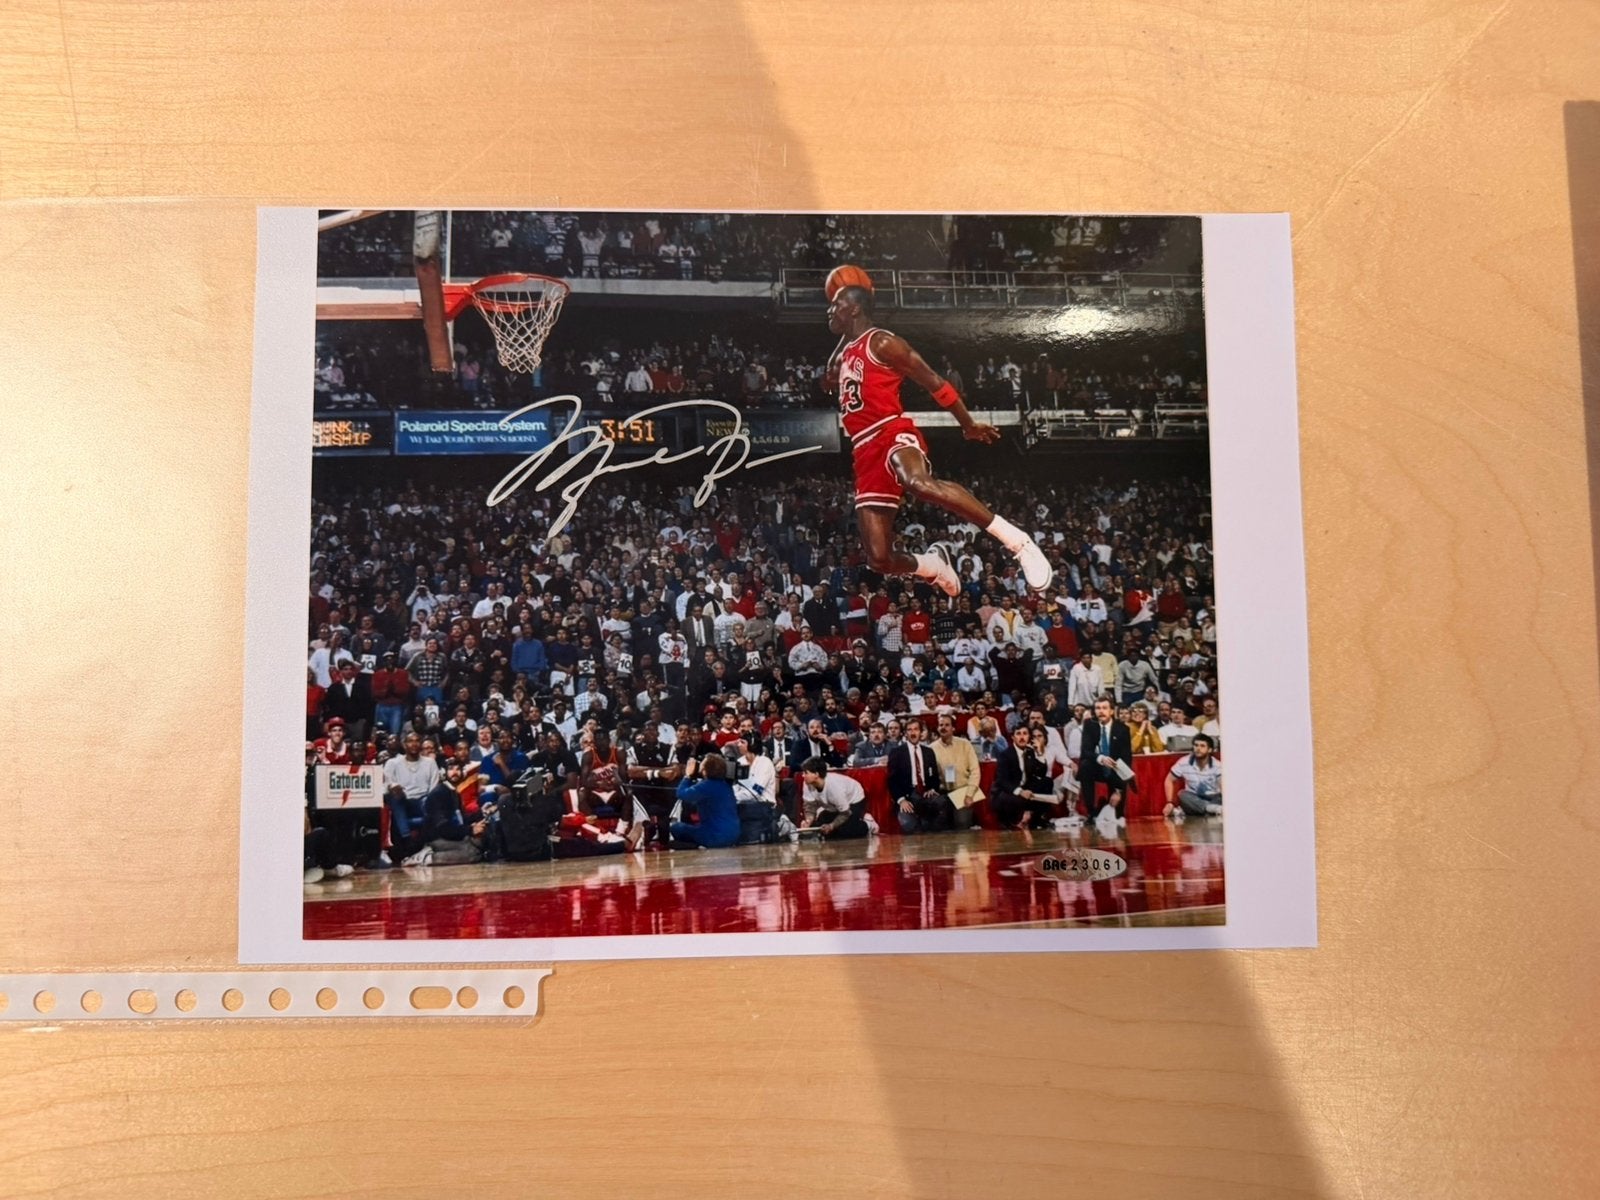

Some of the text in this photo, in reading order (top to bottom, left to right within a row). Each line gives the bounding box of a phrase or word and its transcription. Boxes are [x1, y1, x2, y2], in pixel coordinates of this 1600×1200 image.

[399, 420, 449, 432] Polaroid
[450, 420, 498, 433] Spectra
[600, 419, 655, 442] 3:51
[329, 771, 371, 789] Gatorade
